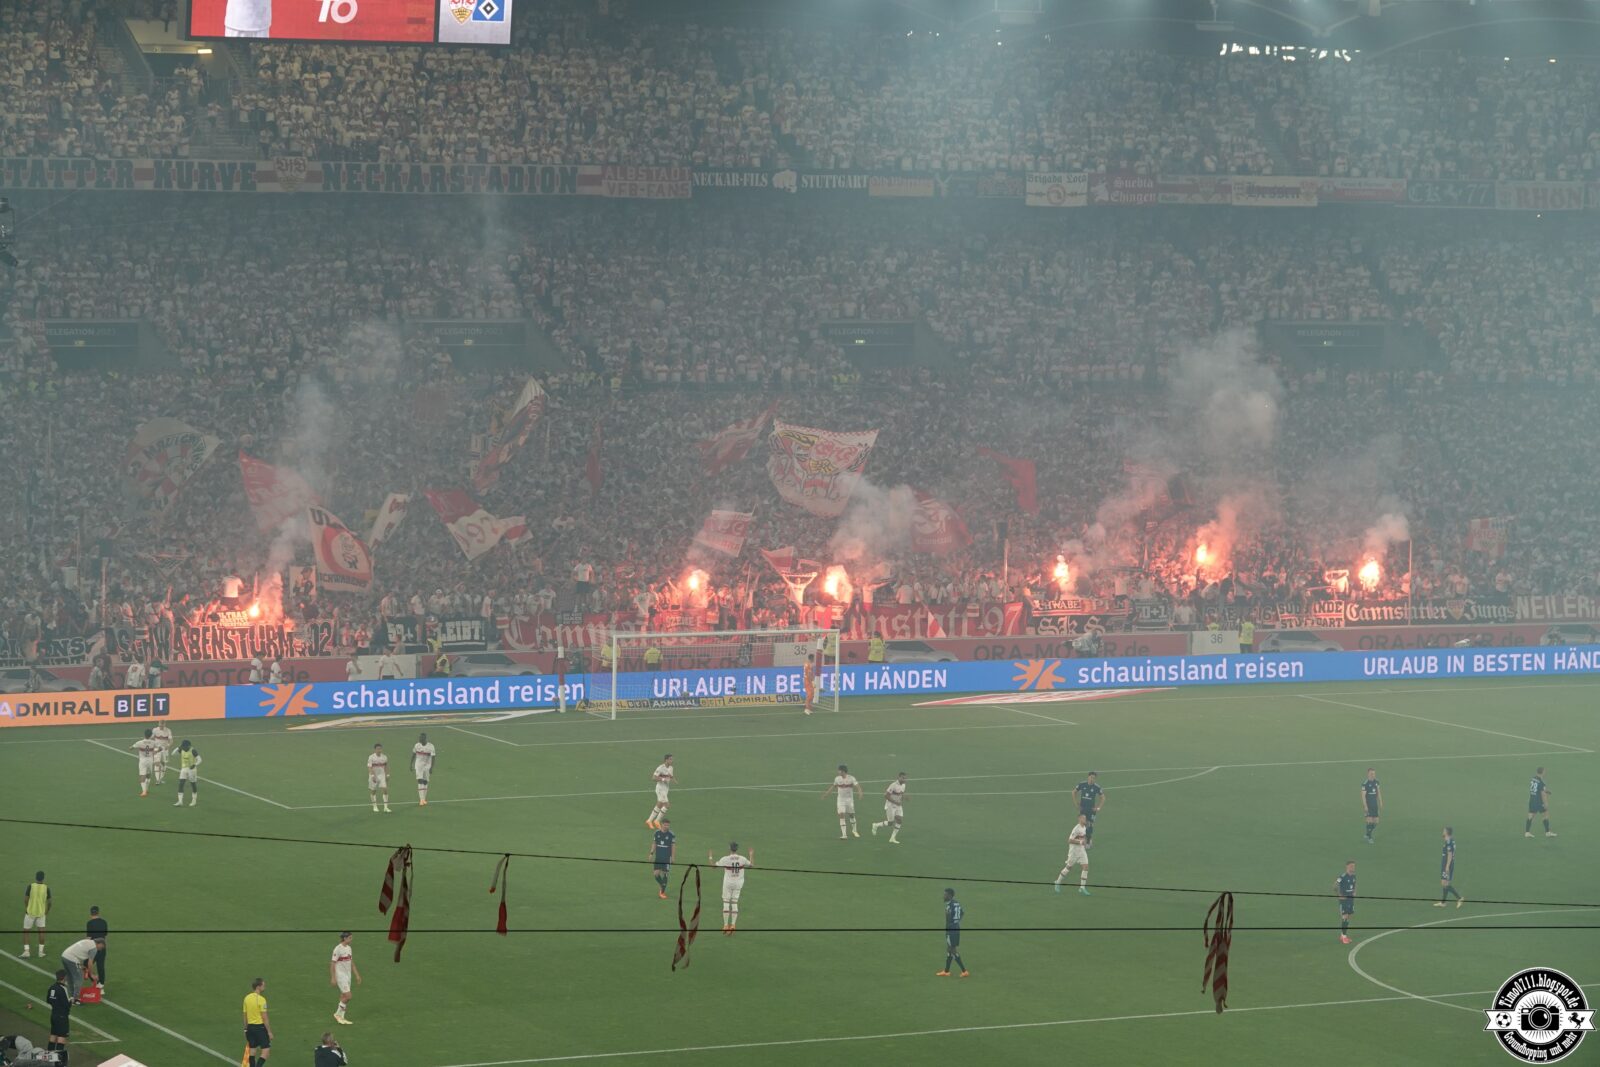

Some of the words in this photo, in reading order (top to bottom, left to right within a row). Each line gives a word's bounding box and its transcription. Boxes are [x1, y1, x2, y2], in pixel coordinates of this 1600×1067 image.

[0, 158, 134, 188] TATTER
[153, 160, 256, 190] KURVE
[321, 162, 577, 193] NECKARSTADION
[801, 174, 868, 190] STUTTGART
[118, 621, 293, 662] SHWABENSTURM
[794, 646, 808, 656] 35
[1210, 636, 1224, 646] 36
[1078, 658, 1227, 686] schauinsland
[1235, 657, 1304, 680] reisen
[1364, 655, 1438, 676] URLAUB
[1447, 655, 1465, 673] IN
[1473, 653, 1546, 673] BESTEN
[332, 682, 499, 710] schauinsland
[508, 680, 585, 704] reisen
[654, 676, 736, 699] URLAUB
[746, 675, 766, 694] IN
[776, 671, 855, 693] BETEN
[865, 666, 947, 690] HÄNDEN
[0, 697, 109, 719] ADMIRAL
[115, 694, 169, 717] BET
[728, 693, 775, 704] ADMIRAL
